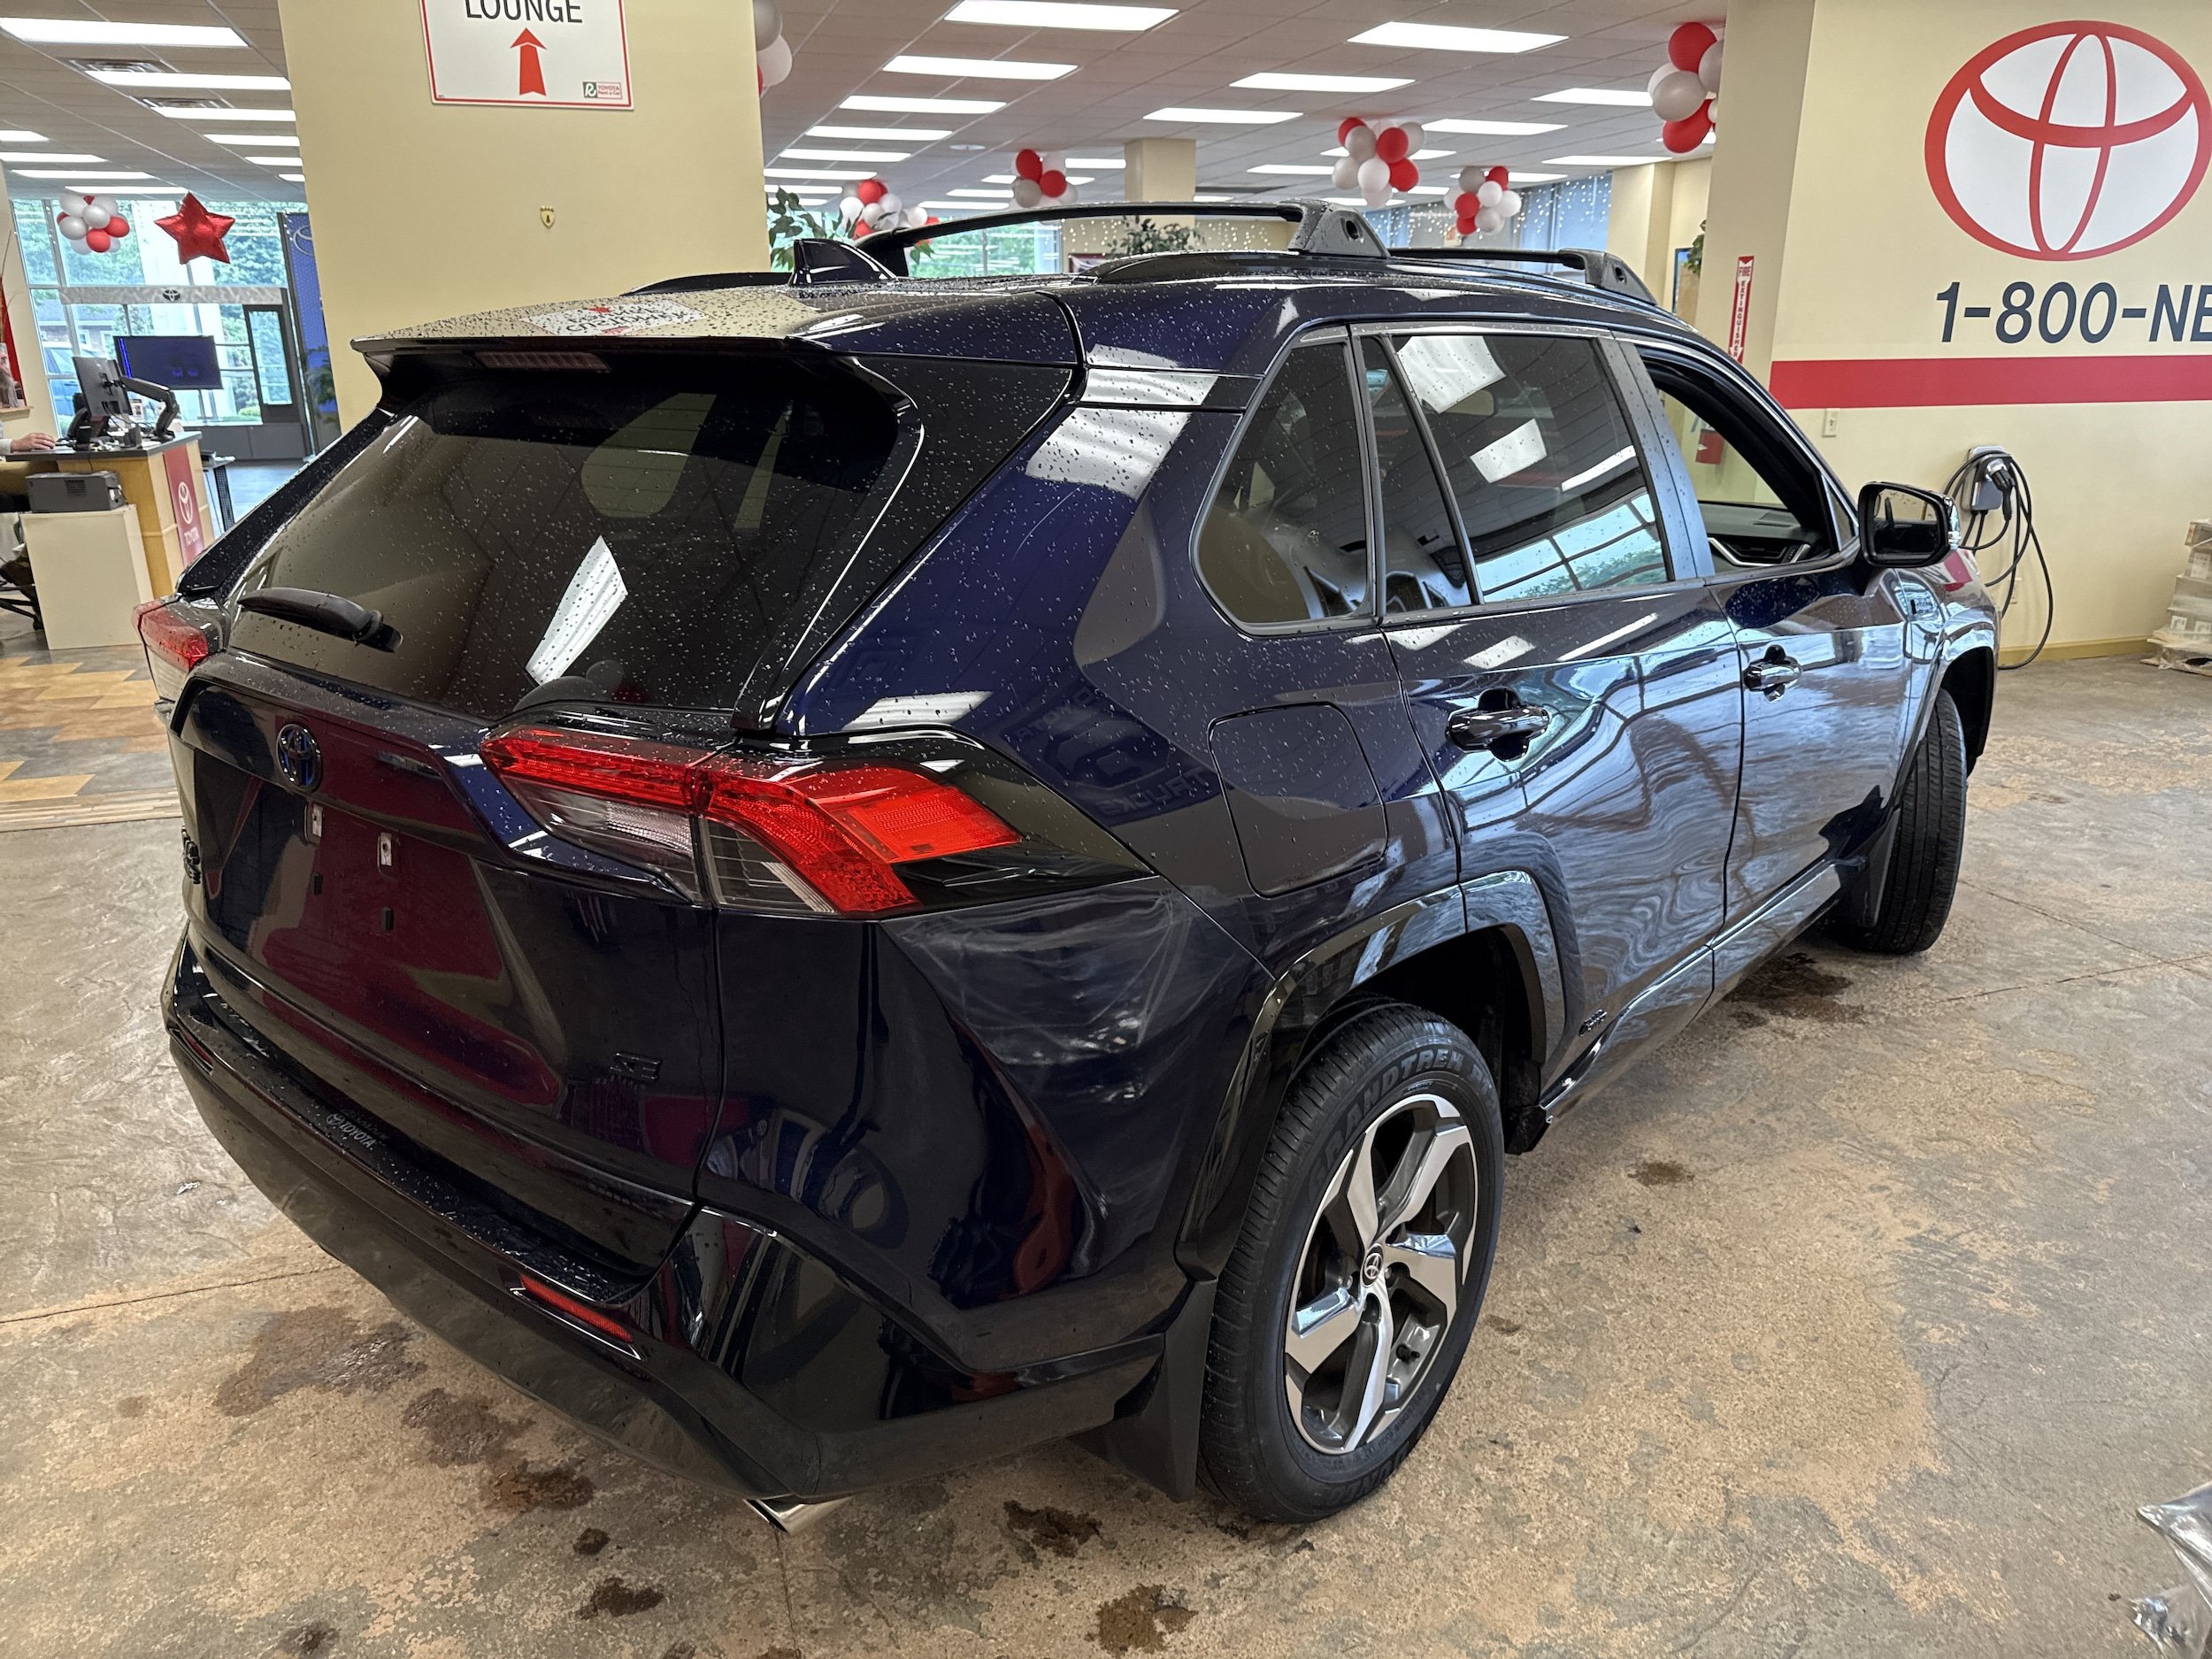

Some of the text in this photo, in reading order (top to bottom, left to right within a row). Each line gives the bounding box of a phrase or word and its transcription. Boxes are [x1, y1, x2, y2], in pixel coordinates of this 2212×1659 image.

[465, 0, 583, 24] LOUNGE
[1739, 266, 1752, 277] FIRE
[339, 1120, 376, 1148] TOYOTA
